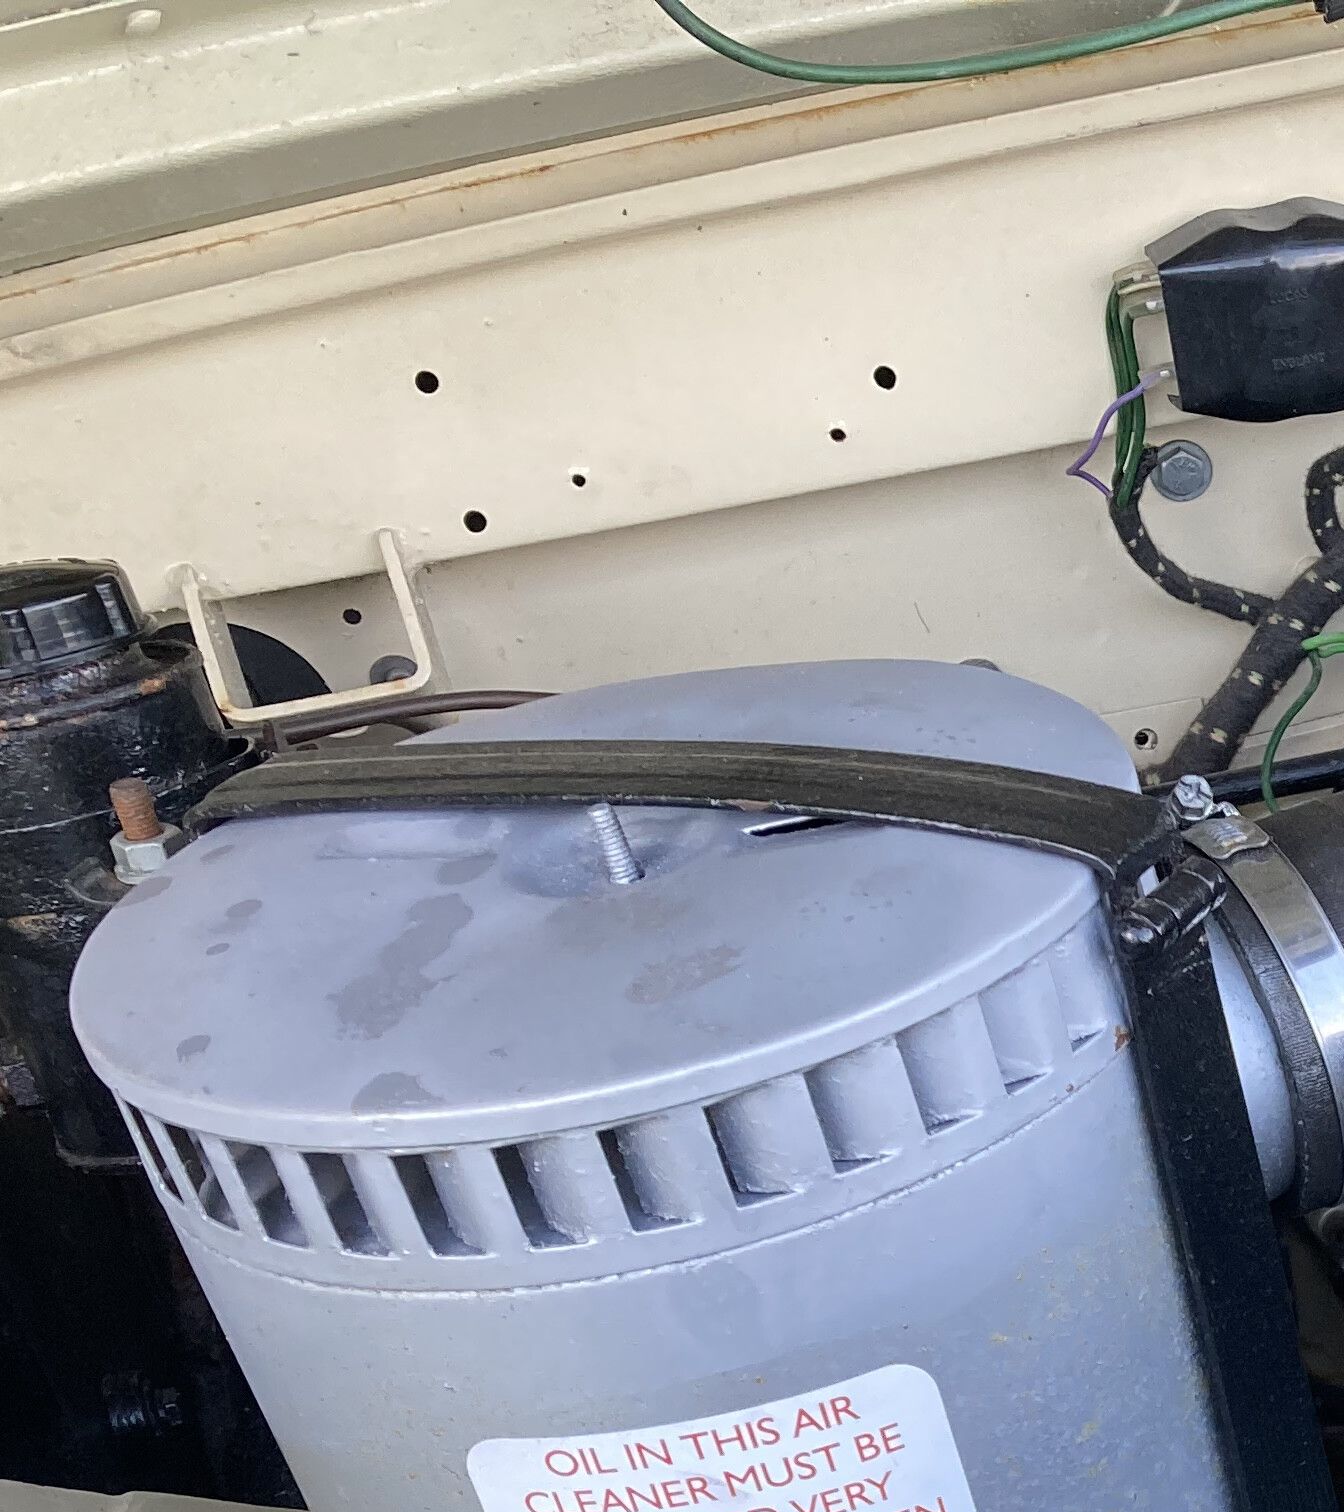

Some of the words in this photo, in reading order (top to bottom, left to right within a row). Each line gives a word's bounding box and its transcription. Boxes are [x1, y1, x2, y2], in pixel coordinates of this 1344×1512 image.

[544, 1446, 617, 1477] OIL
[625, 1442, 674, 1471] IN
[679, 1417, 781, 1461] THIS
[793, 1395, 862, 1437] AIR
[726, 1445, 841, 1499] MUST
[855, 1423, 906, 1462] BE
